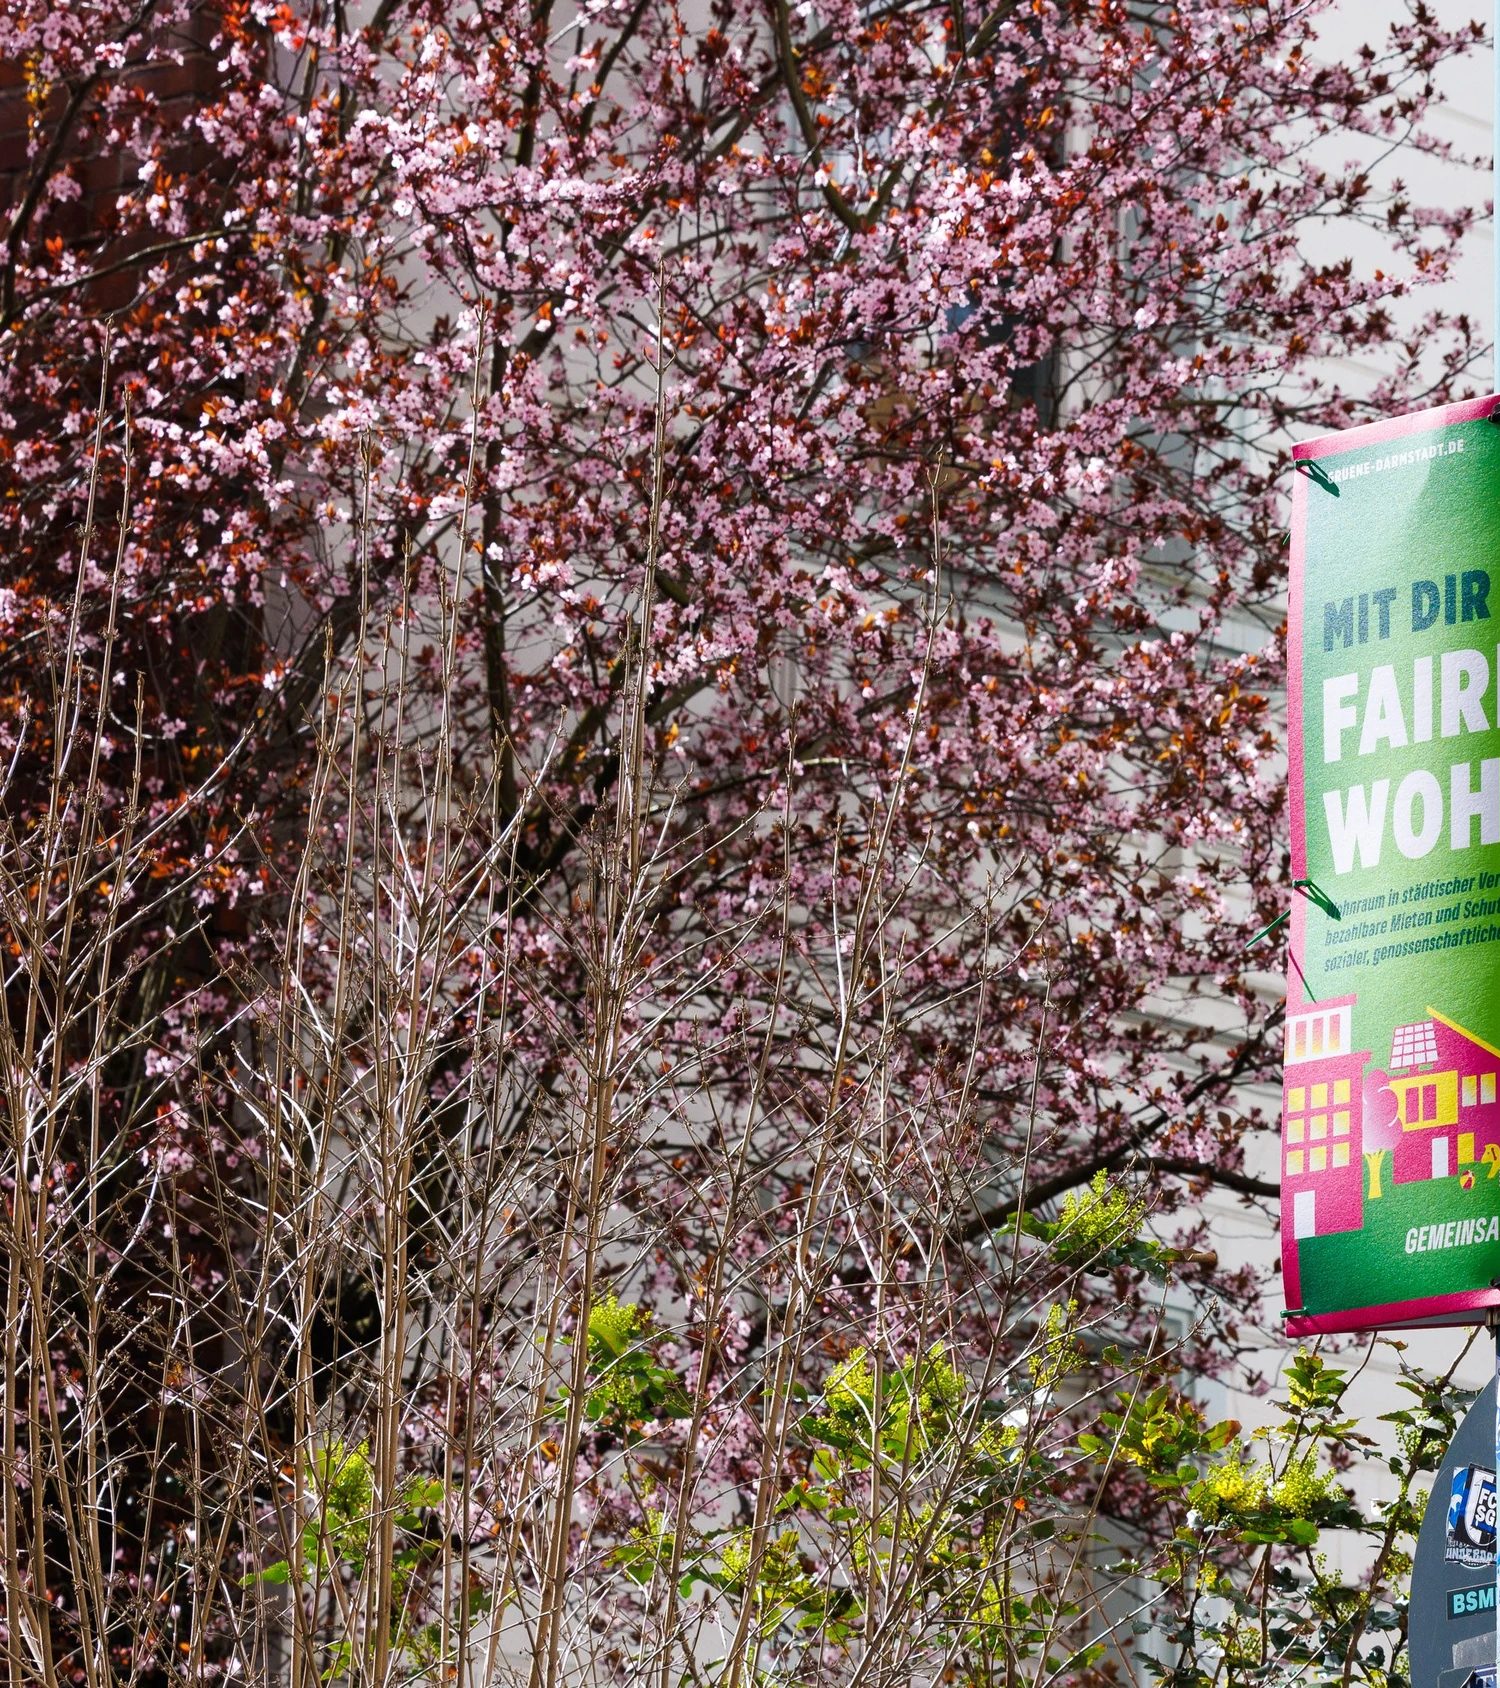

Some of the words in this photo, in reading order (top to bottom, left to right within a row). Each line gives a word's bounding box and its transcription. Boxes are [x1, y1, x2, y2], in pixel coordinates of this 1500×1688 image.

[1327, 439, 1464, 484] GRUENE-DARMSTADT.DE
[1323, 587, 1397, 653] MIT
[1411, 569, 1491, 633] DIR
[1388, 889, 1399, 907] in
[1402, 876, 1475, 903] städtischer
[1324, 920, 1388, 947] bezahlbare
[1390, 911, 1432, 932] Mieten
[1435, 902, 1461, 923] und
[1324, 949, 1370, 973] sozialer,
[1475, 1505, 1497, 1526] SG
[1453, 1587, 1497, 1614] BSM
